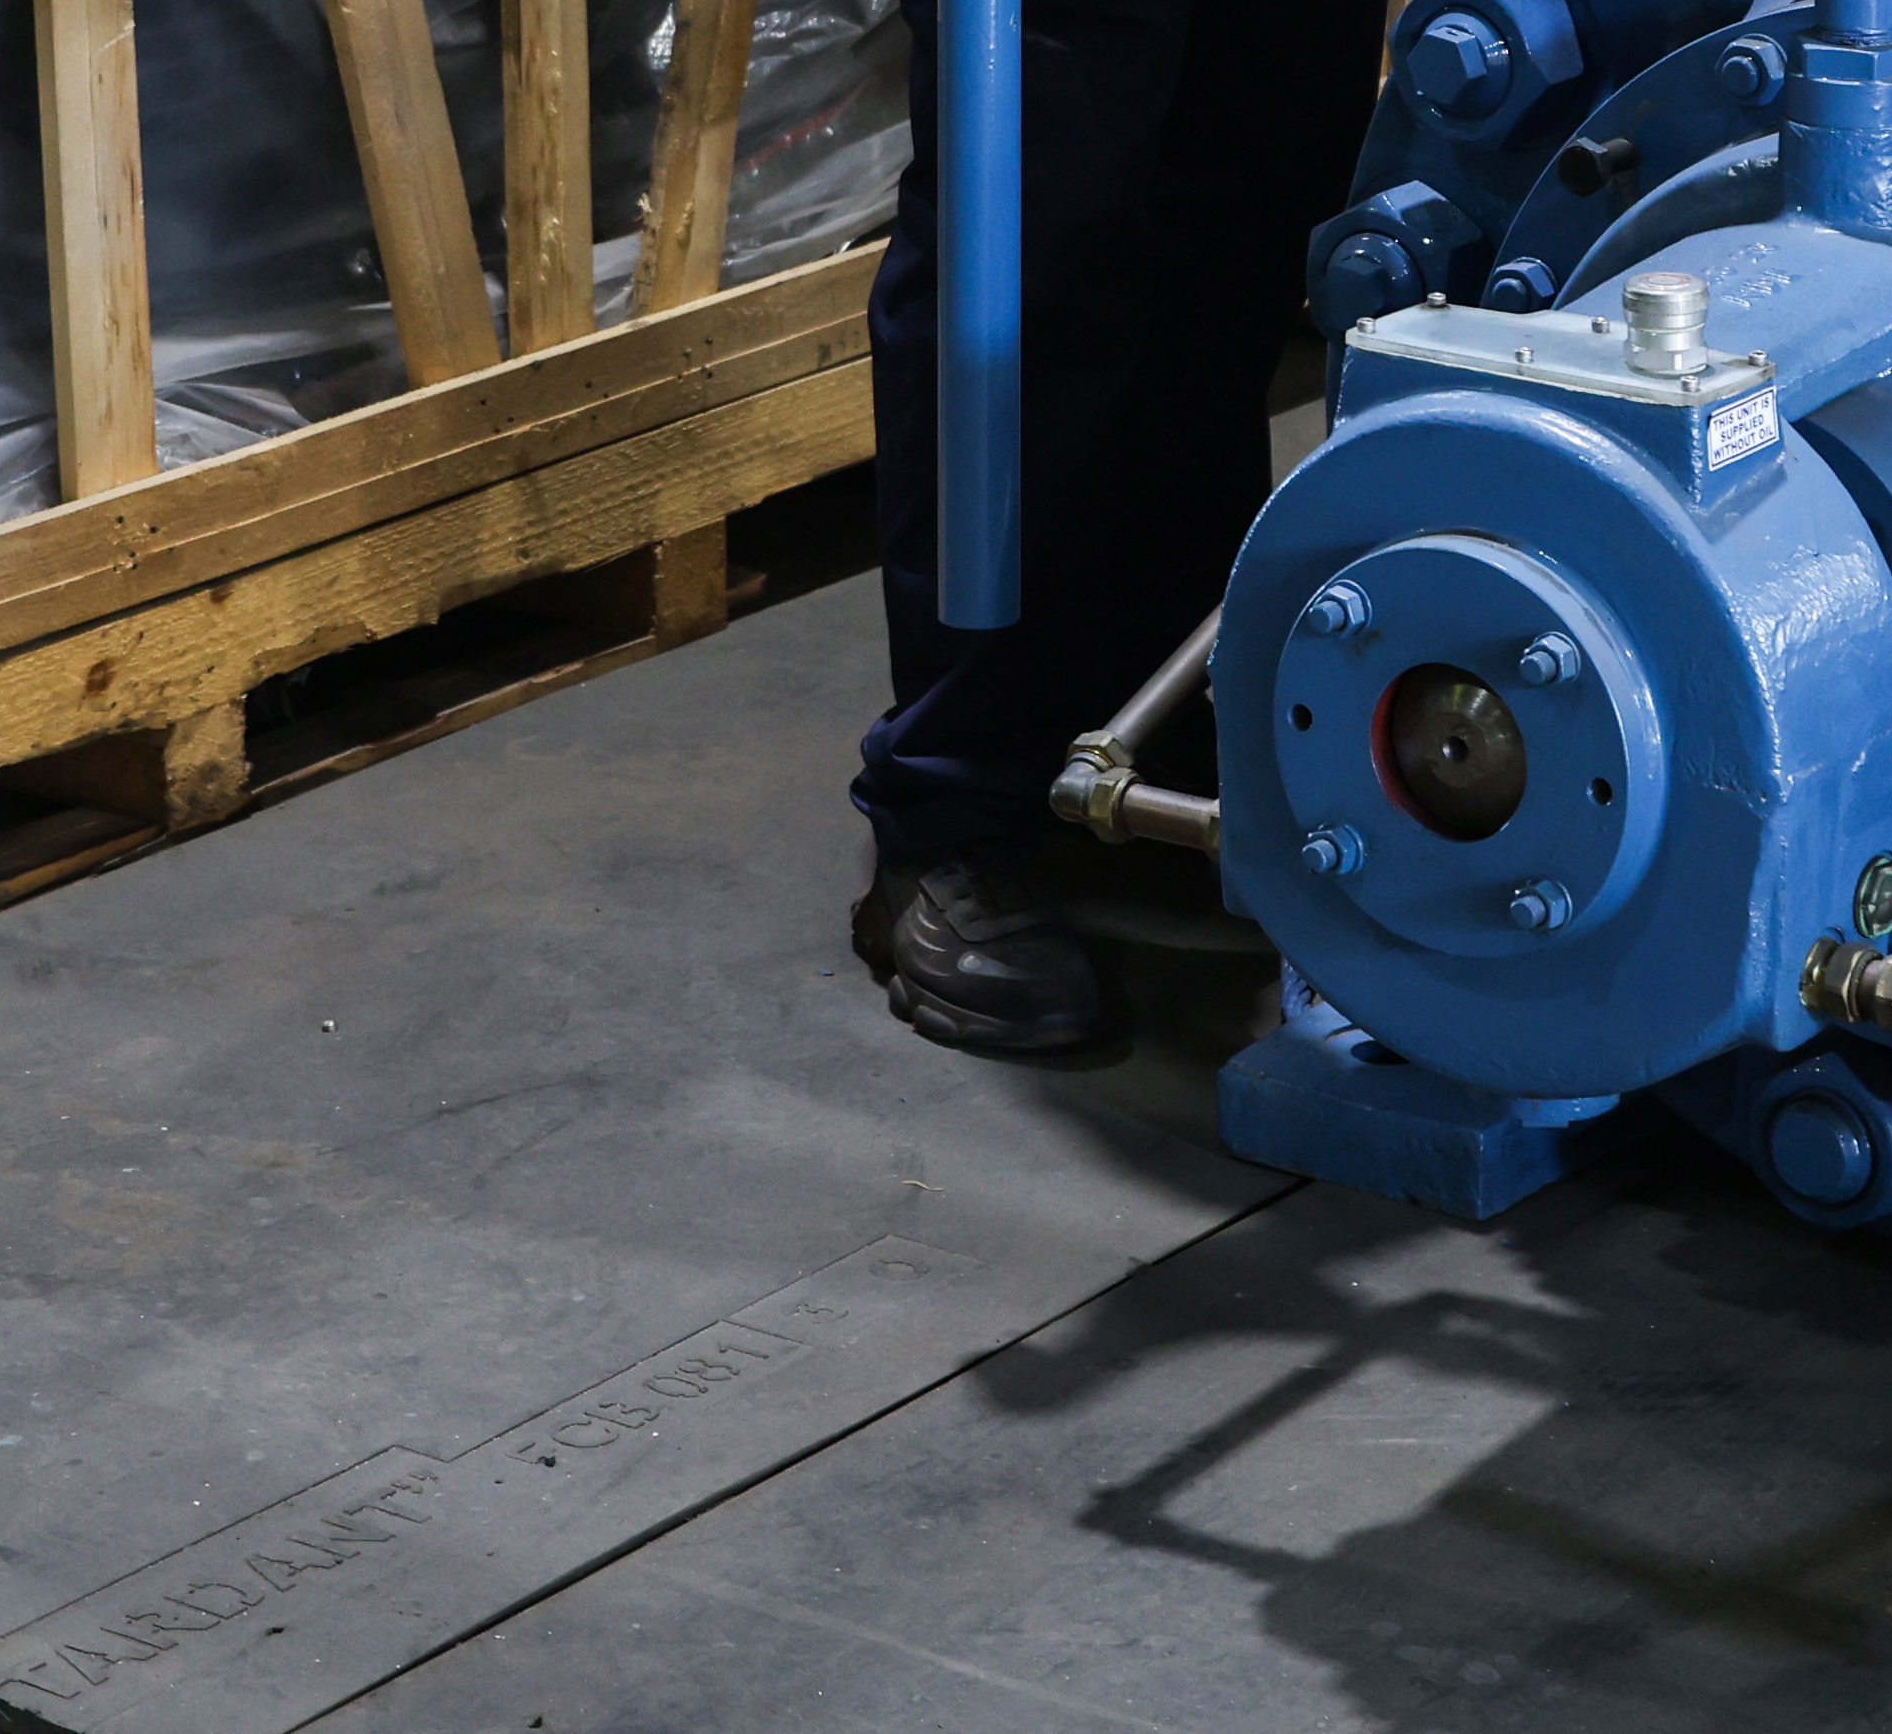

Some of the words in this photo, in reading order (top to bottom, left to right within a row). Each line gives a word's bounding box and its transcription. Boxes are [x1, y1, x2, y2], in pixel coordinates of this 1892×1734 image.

[1713, 413, 1734, 431] THIS
[1737, 401, 1758, 420] UNIT
[1762, 396, 1770, 409] IS
[1720, 414, 1764, 443] SUPPLIED
[1713, 432, 1756, 461] WITHOUT
[1759, 425, 1774, 440] OIL
